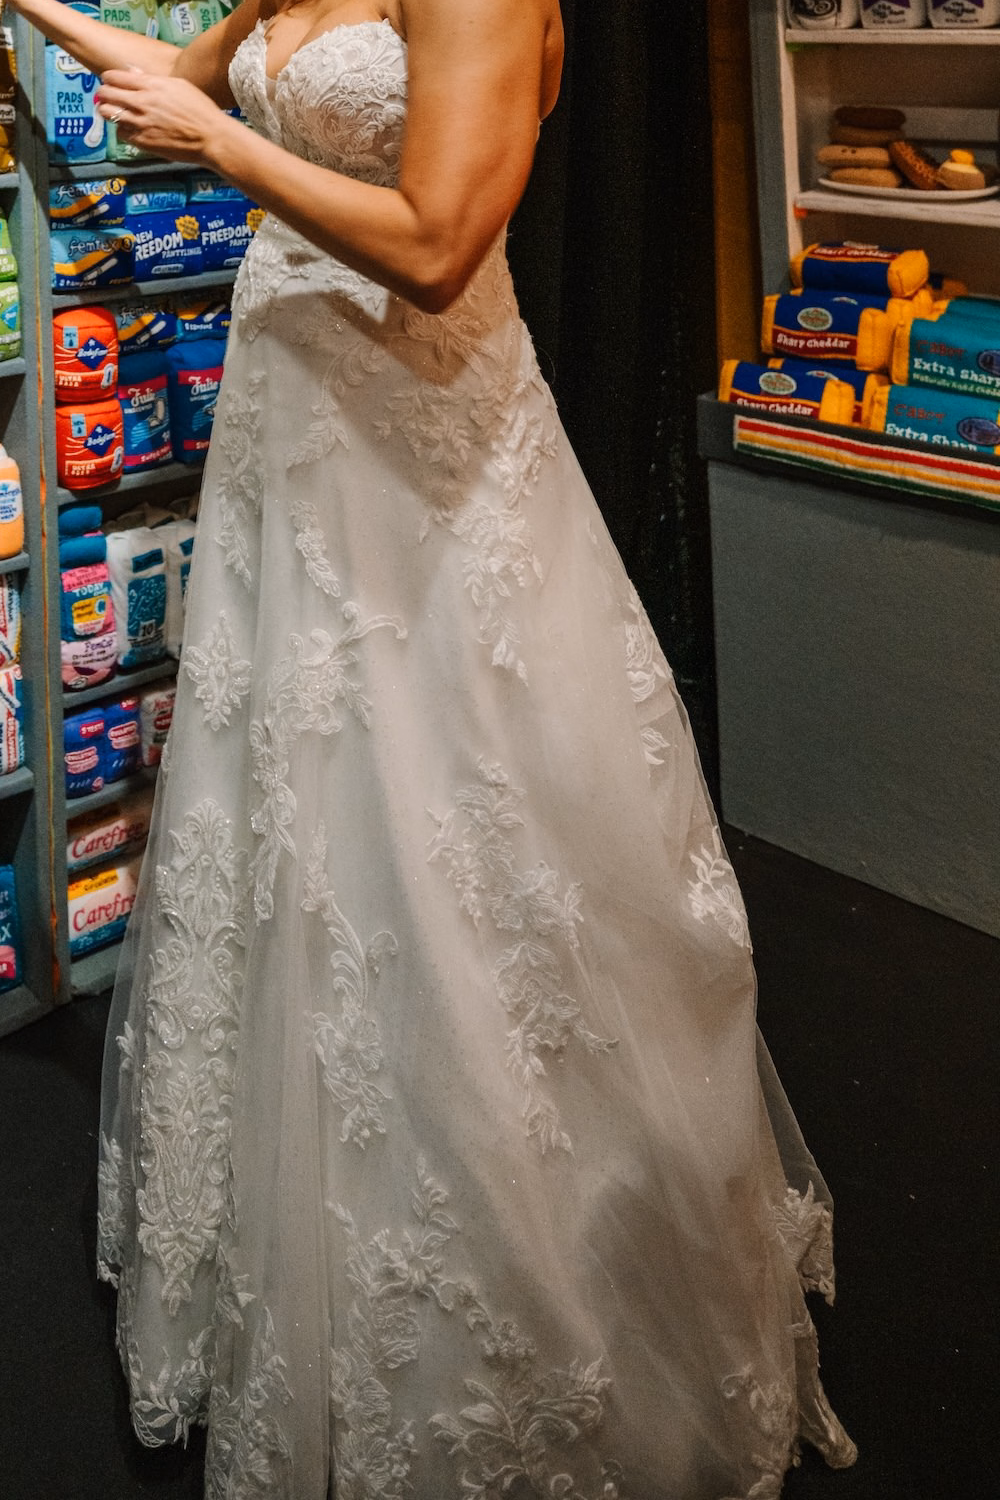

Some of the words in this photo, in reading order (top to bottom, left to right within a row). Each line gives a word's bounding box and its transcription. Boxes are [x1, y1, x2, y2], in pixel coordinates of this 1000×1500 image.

[103, 9, 131, 22] PADS
[180, 6, 191, 33] TENA
[57, 92, 84, 103] PADS
[58, 104, 84, 114] MAXI
[207, 219, 225, 230] NEW
[135, 230, 153, 245] NEW
[201, 224, 253, 246] FREEDOM
[135, 232, 184, 262] REEDOM
[777, 333, 804, 349] Sharp
[806, 336, 850, 349] Cheddar
[913, 357, 955, 377] Extra
[769, 401, 813, 416] Cheddar
[885, 423, 928, 443] Extra
[71, 819, 145, 860] Carefree
